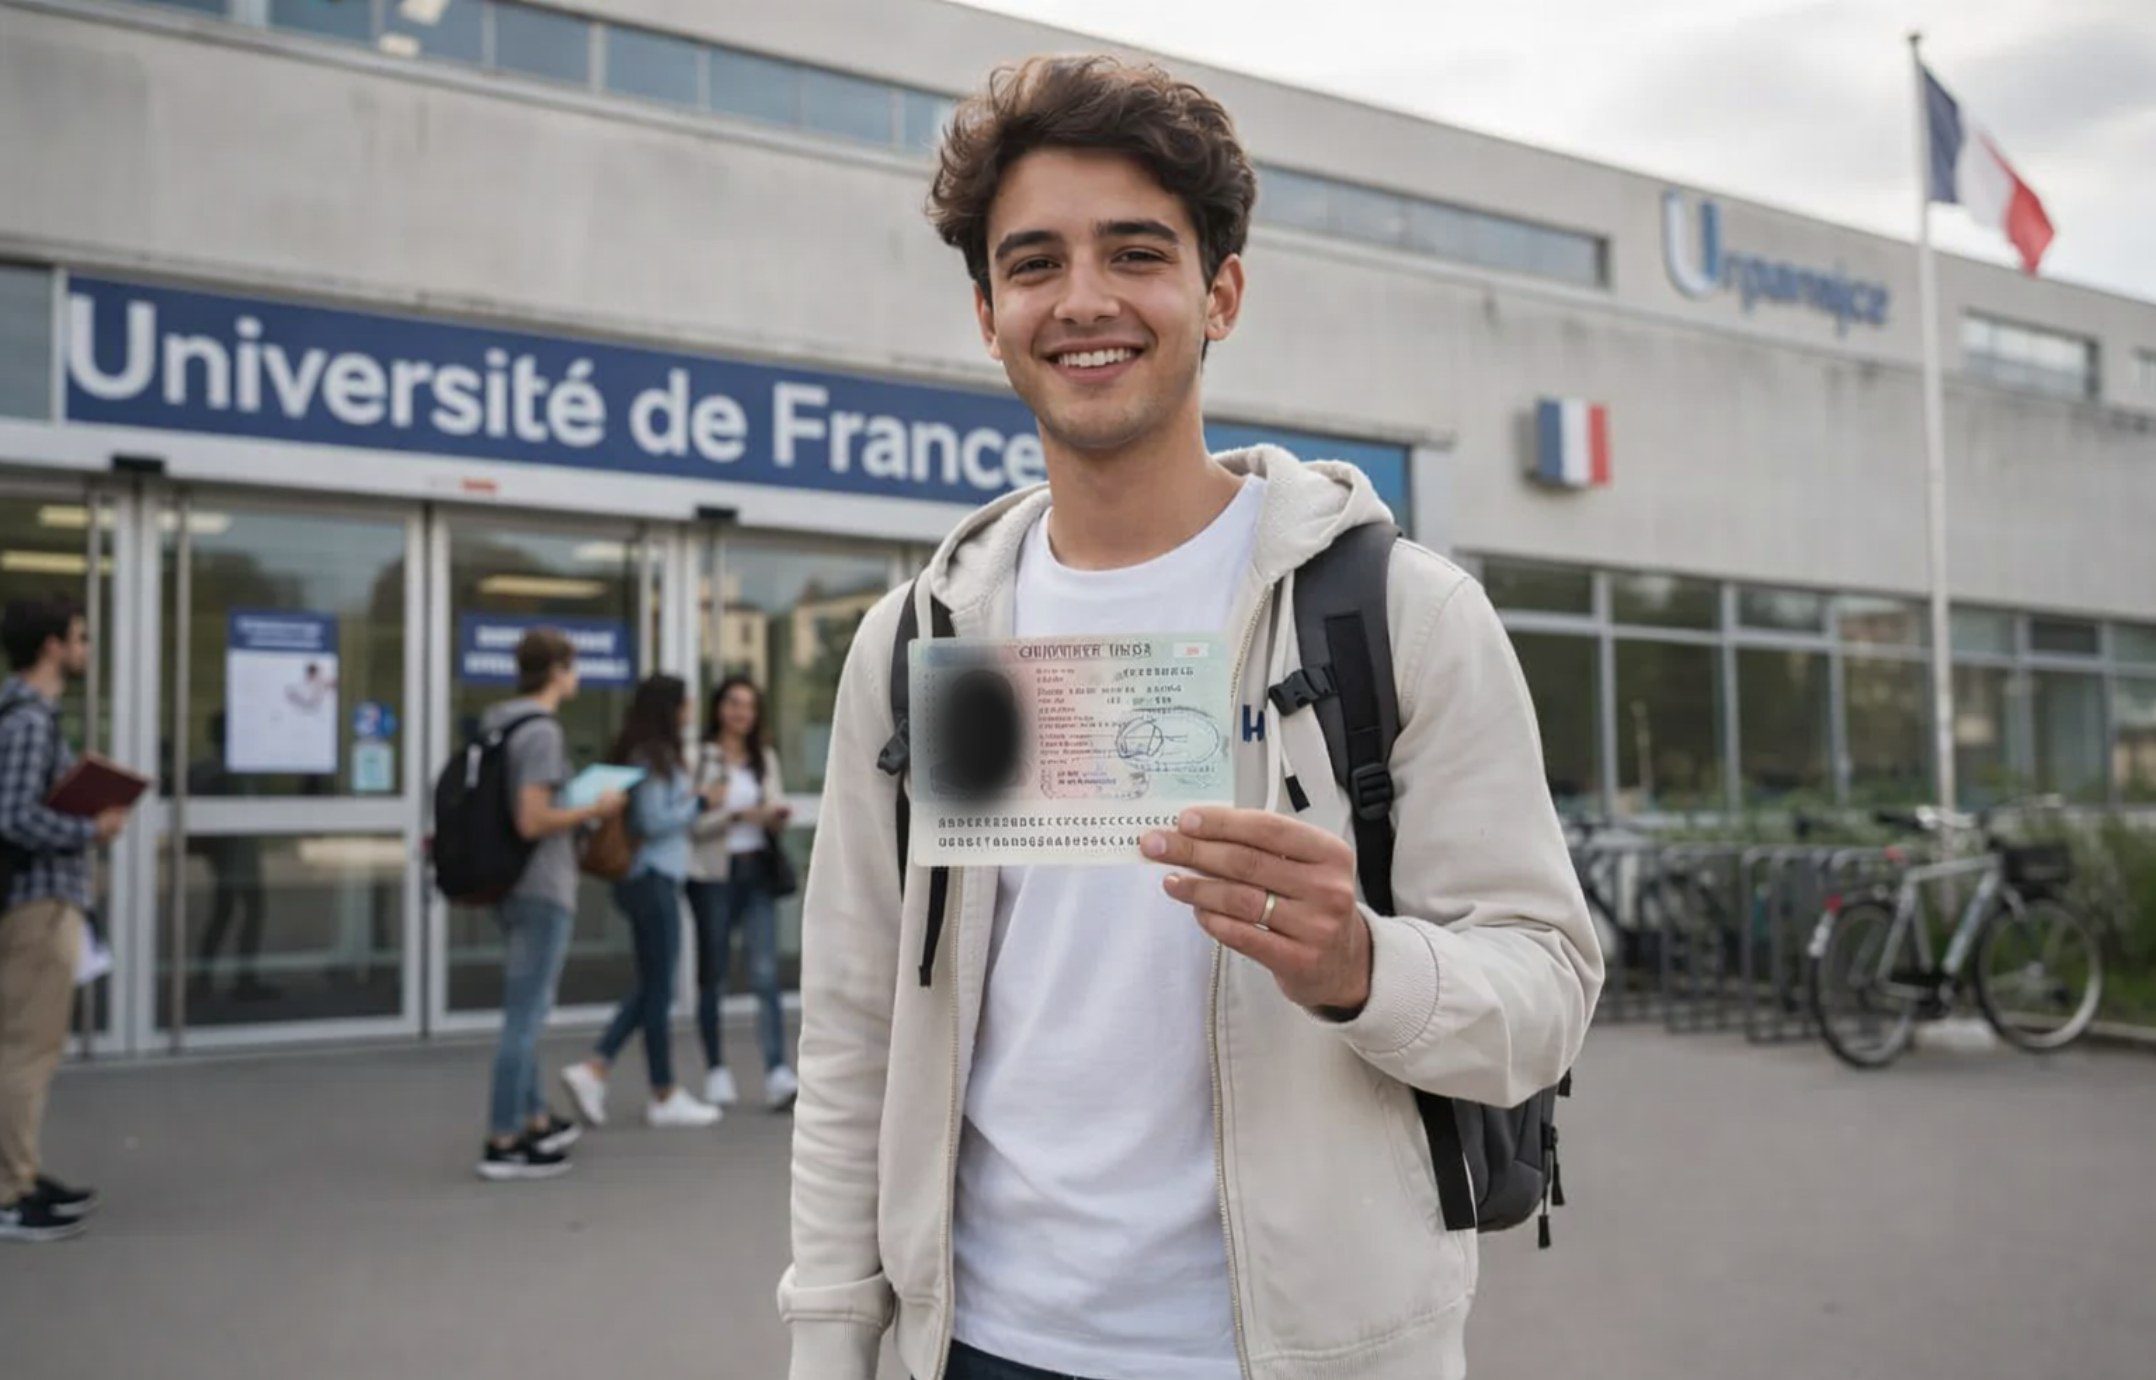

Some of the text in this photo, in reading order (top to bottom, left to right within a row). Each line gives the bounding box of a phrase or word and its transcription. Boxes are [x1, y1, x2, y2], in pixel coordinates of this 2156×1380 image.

[67, 292, 1047, 490] Université de France
